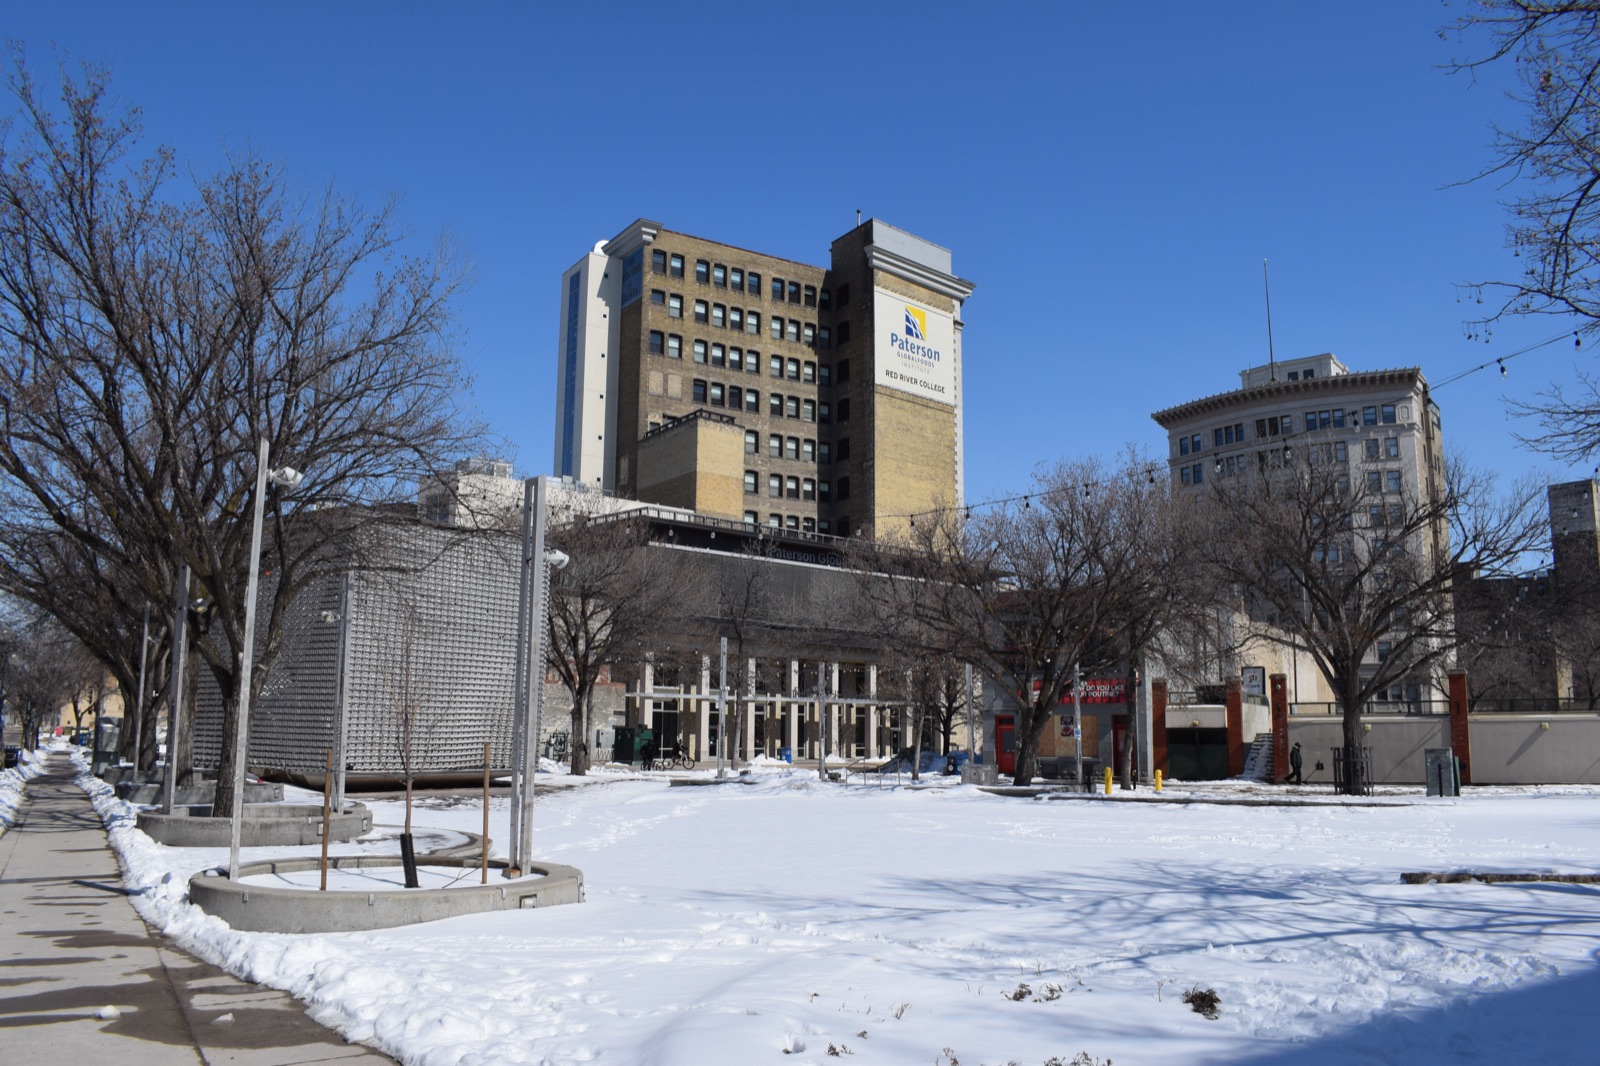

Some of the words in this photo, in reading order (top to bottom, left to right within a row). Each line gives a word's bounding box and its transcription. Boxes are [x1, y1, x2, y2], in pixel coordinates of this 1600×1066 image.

[890, 332, 940, 362] Paterson
[896, 351, 935, 368] GLOBALFOODS
[901, 362, 930, 375] INSTITUTE
[885, 369, 898, 380] RED
[899, 373, 918, 385] RIVER
[919, 379, 945, 394] COLLEGE
[769, 548, 816, 563] Paterson
